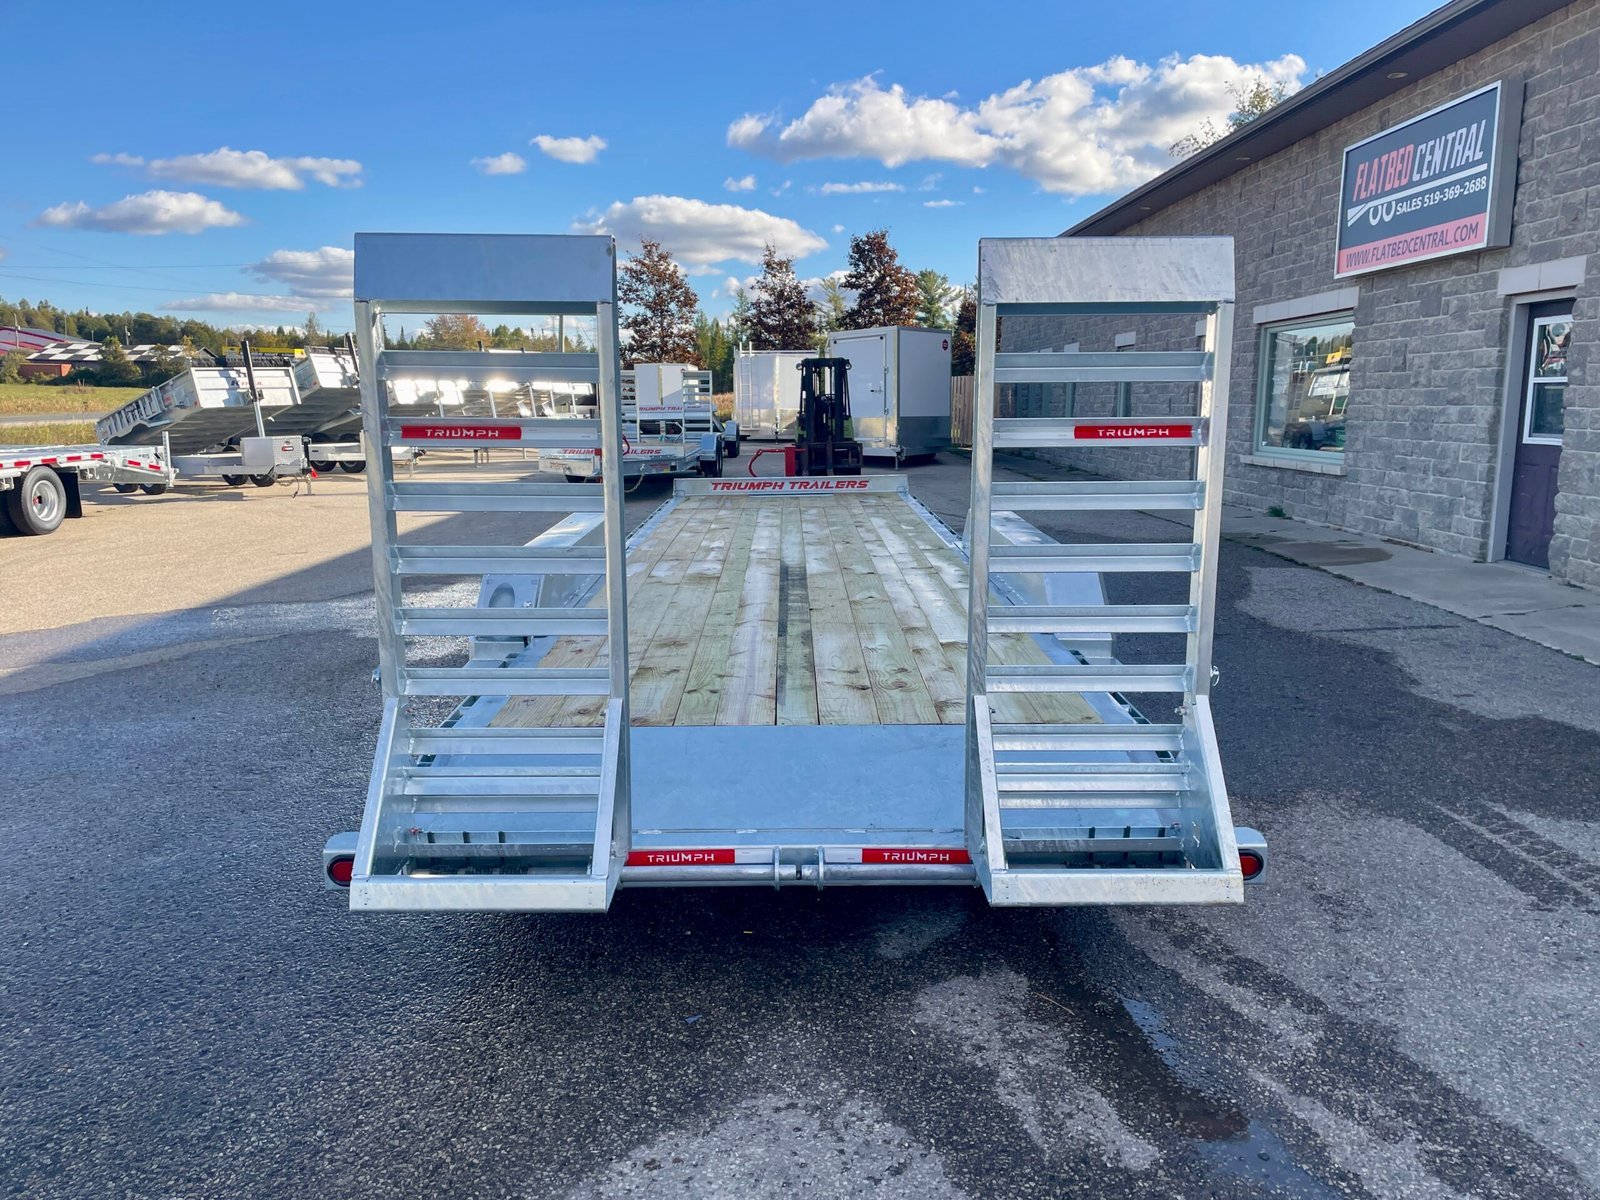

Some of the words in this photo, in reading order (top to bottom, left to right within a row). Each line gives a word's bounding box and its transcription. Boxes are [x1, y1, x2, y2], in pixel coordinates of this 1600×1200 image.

[1353, 143, 1415, 202] FLATBED
[1412, 119, 1486, 182] CENTRAL
[1396, 198, 1422, 215] SALES
[1423, 176, 1487, 208] 519-369-2688
[1346, 221, 1479, 268] WWW.FLATBEDCENTRAL.COM
[425, 428, 499, 437] TRIUMPH
[1097, 427, 1169, 437] TRIUMPH
[711, 481, 785, 491] TRIUMPH
[789, 479, 870, 490] TRAILERS
[647, 852, 715, 863] TRIUMPH
[883, 851, 950, 861] TRIUMPH
